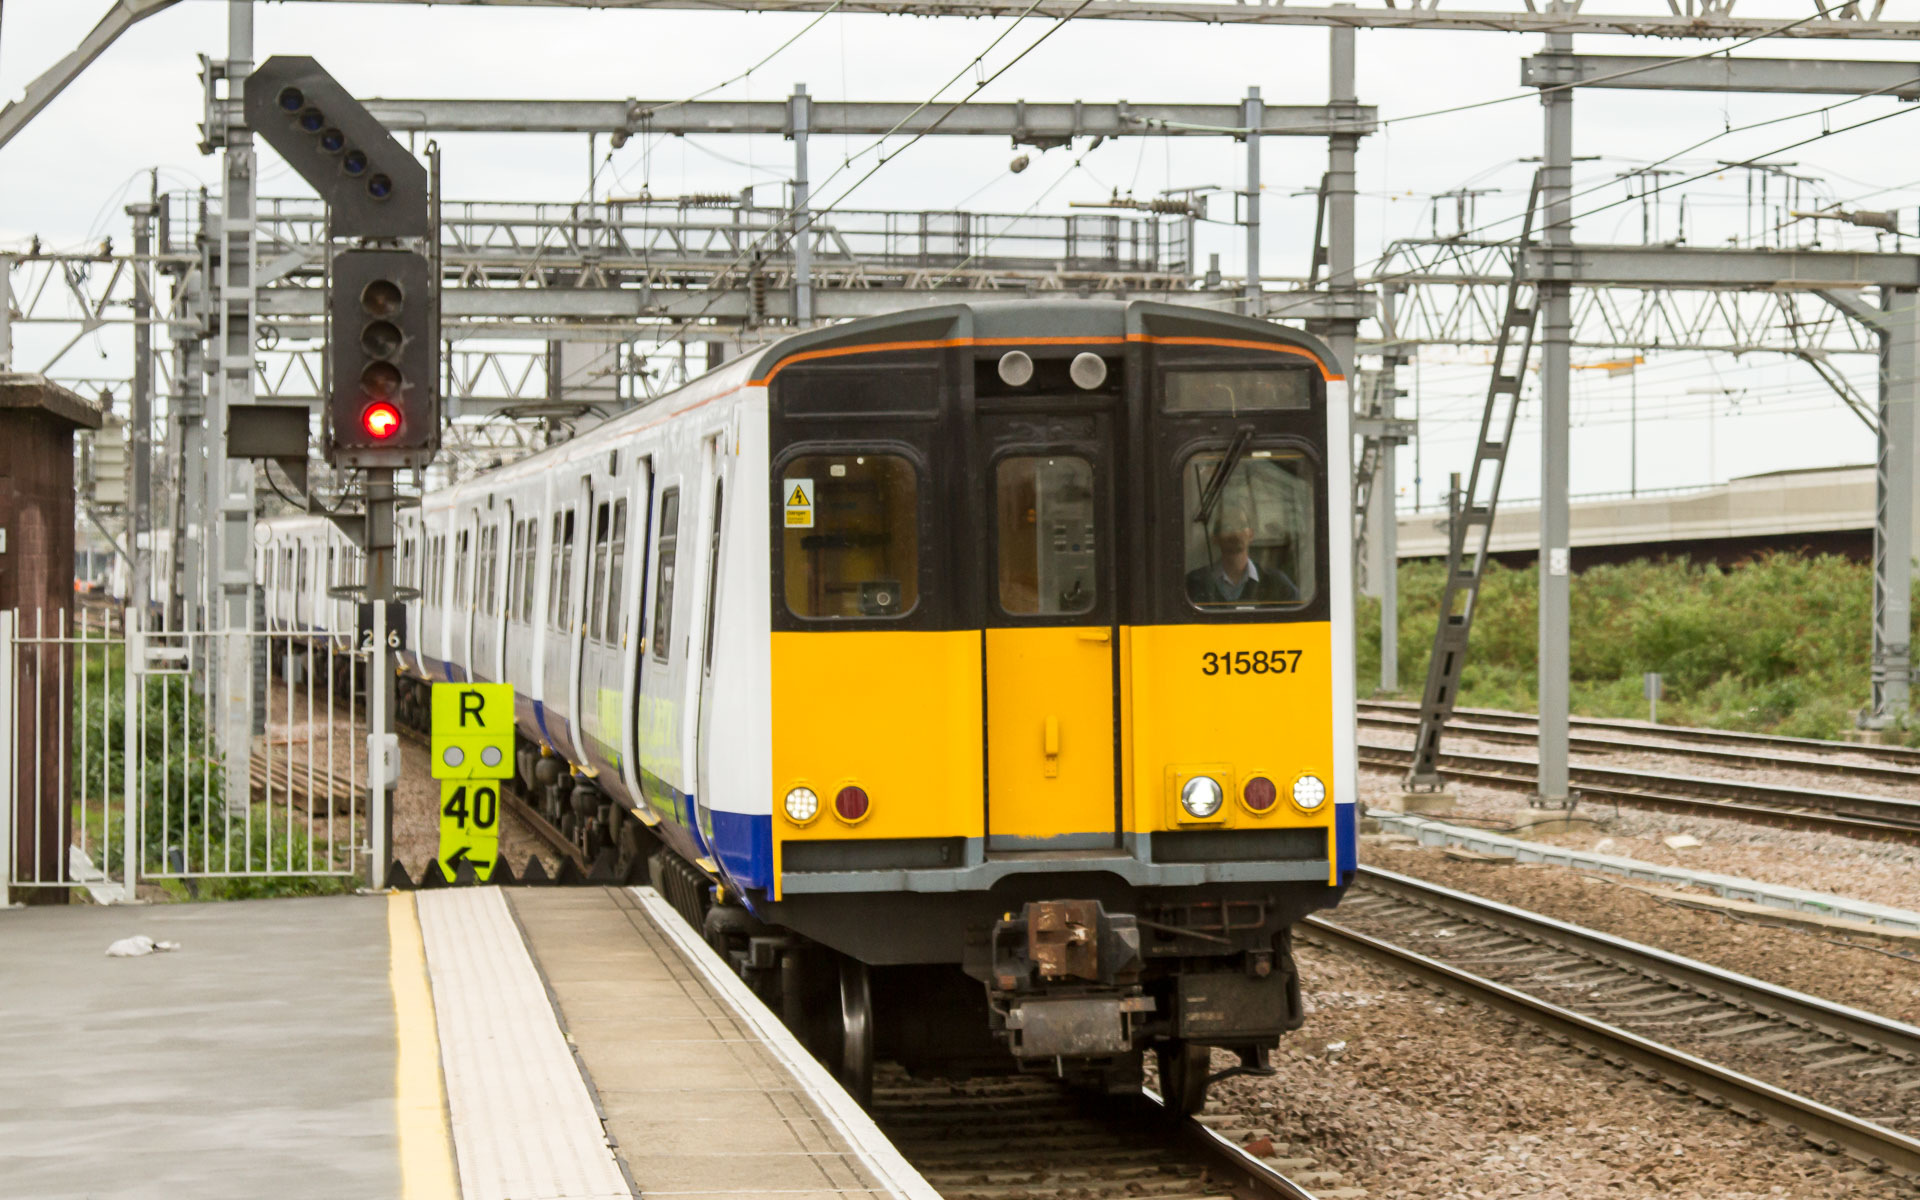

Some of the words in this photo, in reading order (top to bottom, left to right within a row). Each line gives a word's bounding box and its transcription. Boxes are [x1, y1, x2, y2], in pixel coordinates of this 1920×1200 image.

[1202, 650, 1303, 676] 315857
[459, 691, 486, 727] R
[443, 786, 497, 830] 40
